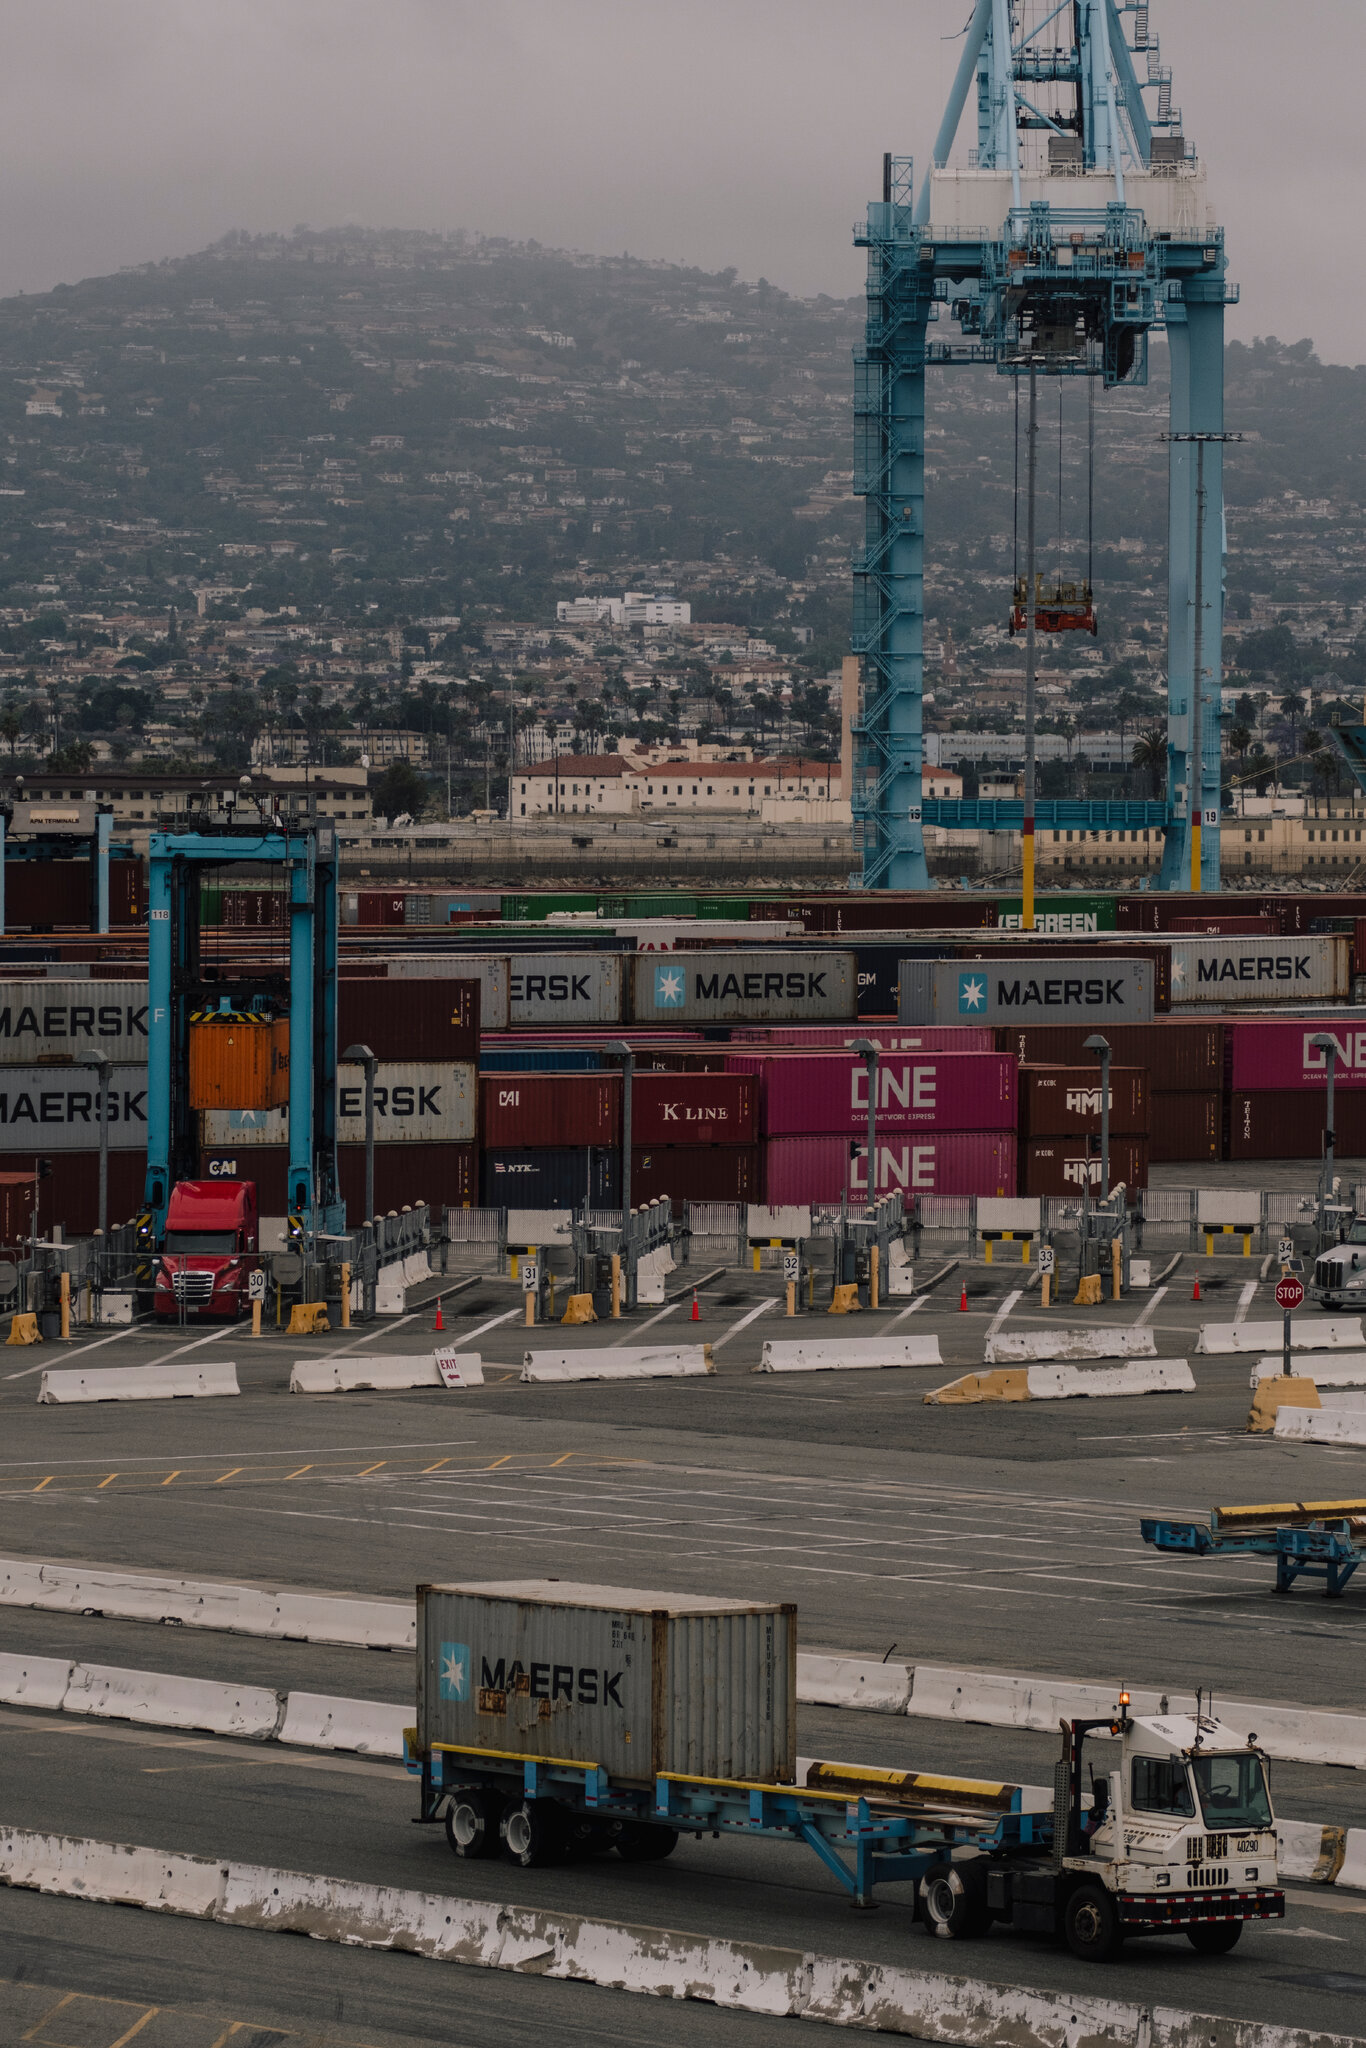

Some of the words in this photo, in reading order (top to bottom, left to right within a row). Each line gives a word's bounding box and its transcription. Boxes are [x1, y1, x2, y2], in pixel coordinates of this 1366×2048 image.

[1205, 811, 1216, 823] 19
[153, 911, 169, 919] 118
[1198, 956, 1311, 982] MAERSK
[696, 972, 827, 999] MAERSK
[998, 979, 1124, 1005] MAERSK
[154, 1008, 165, 1023] F
[851, 1066, 936, 1109] ONE
[499, 1091, 520, 1106] CAI
[686, 1107, 728, 1120] LINE
[908, 1112, 935, 1120] EXPRESS
[209, 1160, 237, 1176] CAI
[508, 1164, 532, 1173] NYK
[1279, 1242, 1292, 1252] 34
[1040, 1250, 1053, 1262] 33
[784, 1257, 798, 1269] 32
[250, 1274, 264, 1286] 30
[525, 1267, 537, 1280] 31
[1277, 1287, 1302, 1299] STOP
[440, 1359, 457, 1370] EXIT
[482, 1656, 624, 1709] MAERSK
[1236, 1840, 1258, 1853] 40290
